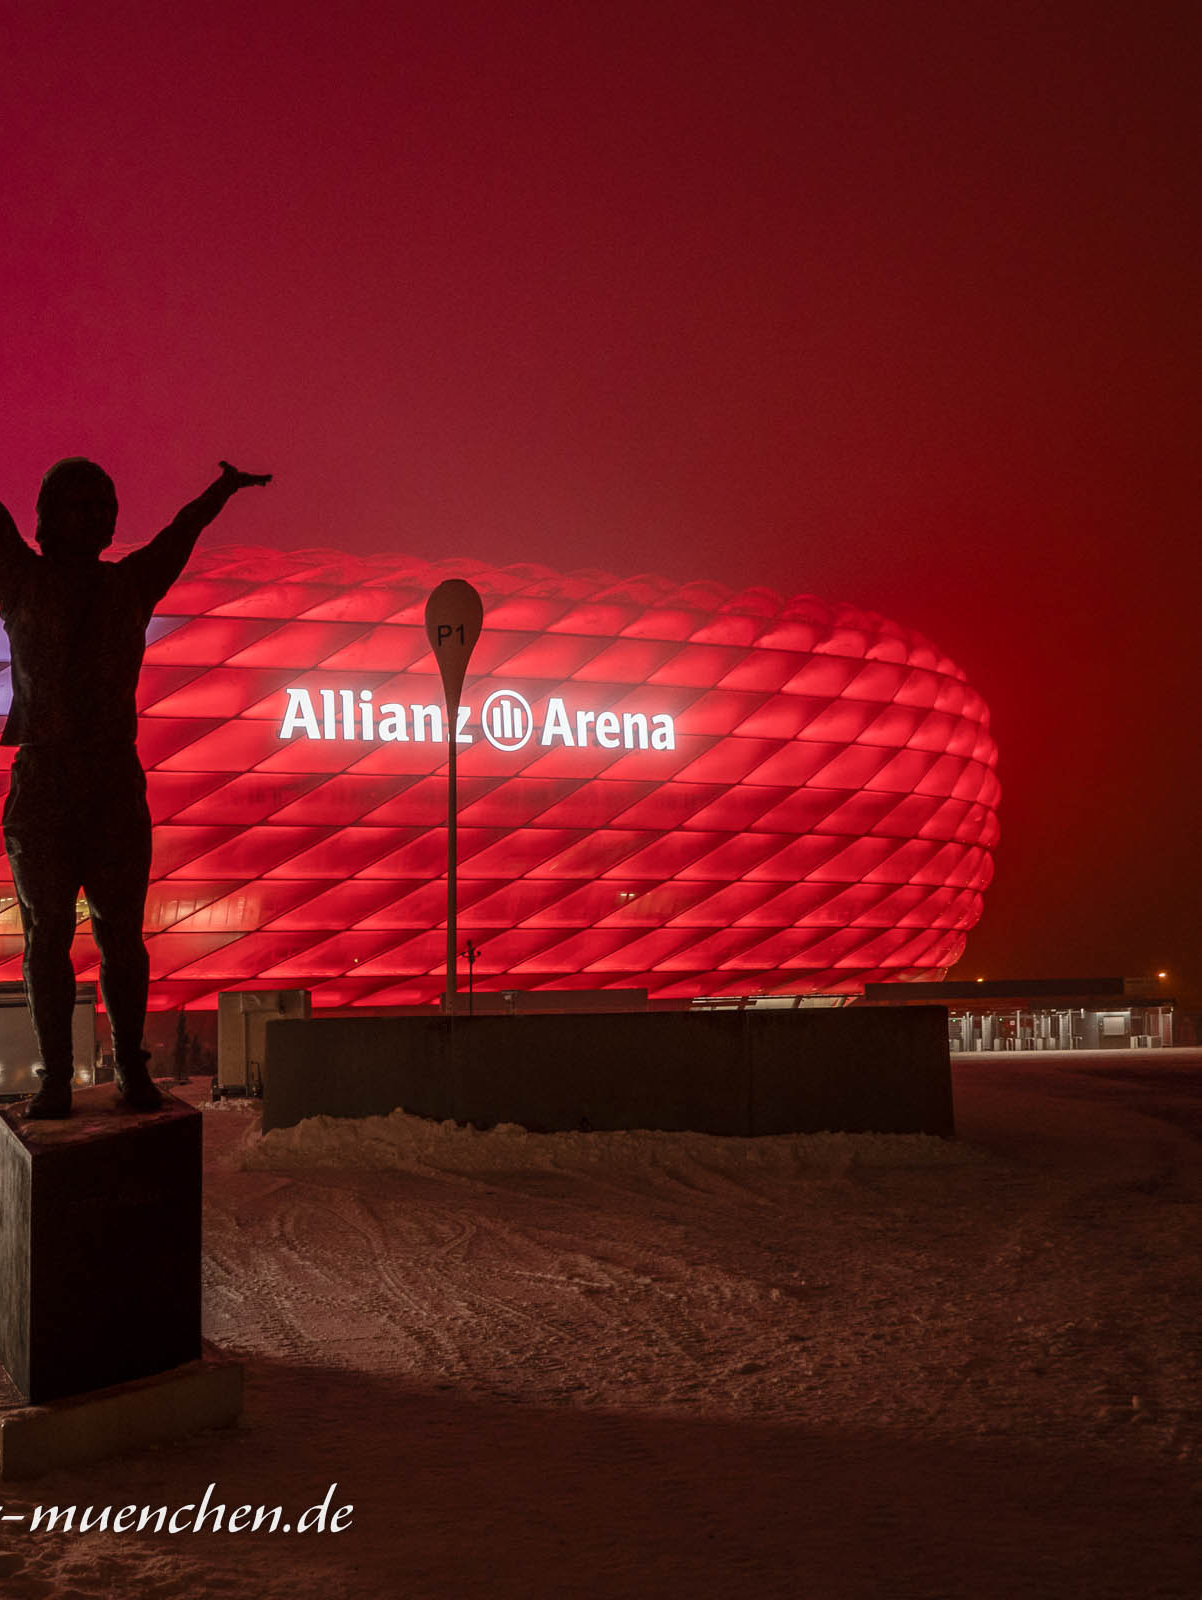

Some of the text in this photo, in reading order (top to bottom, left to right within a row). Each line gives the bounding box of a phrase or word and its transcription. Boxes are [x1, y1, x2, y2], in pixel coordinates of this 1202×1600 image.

[437, 624, 465, 646] P1
[279, 688, 676, 750] Allianz Arena
